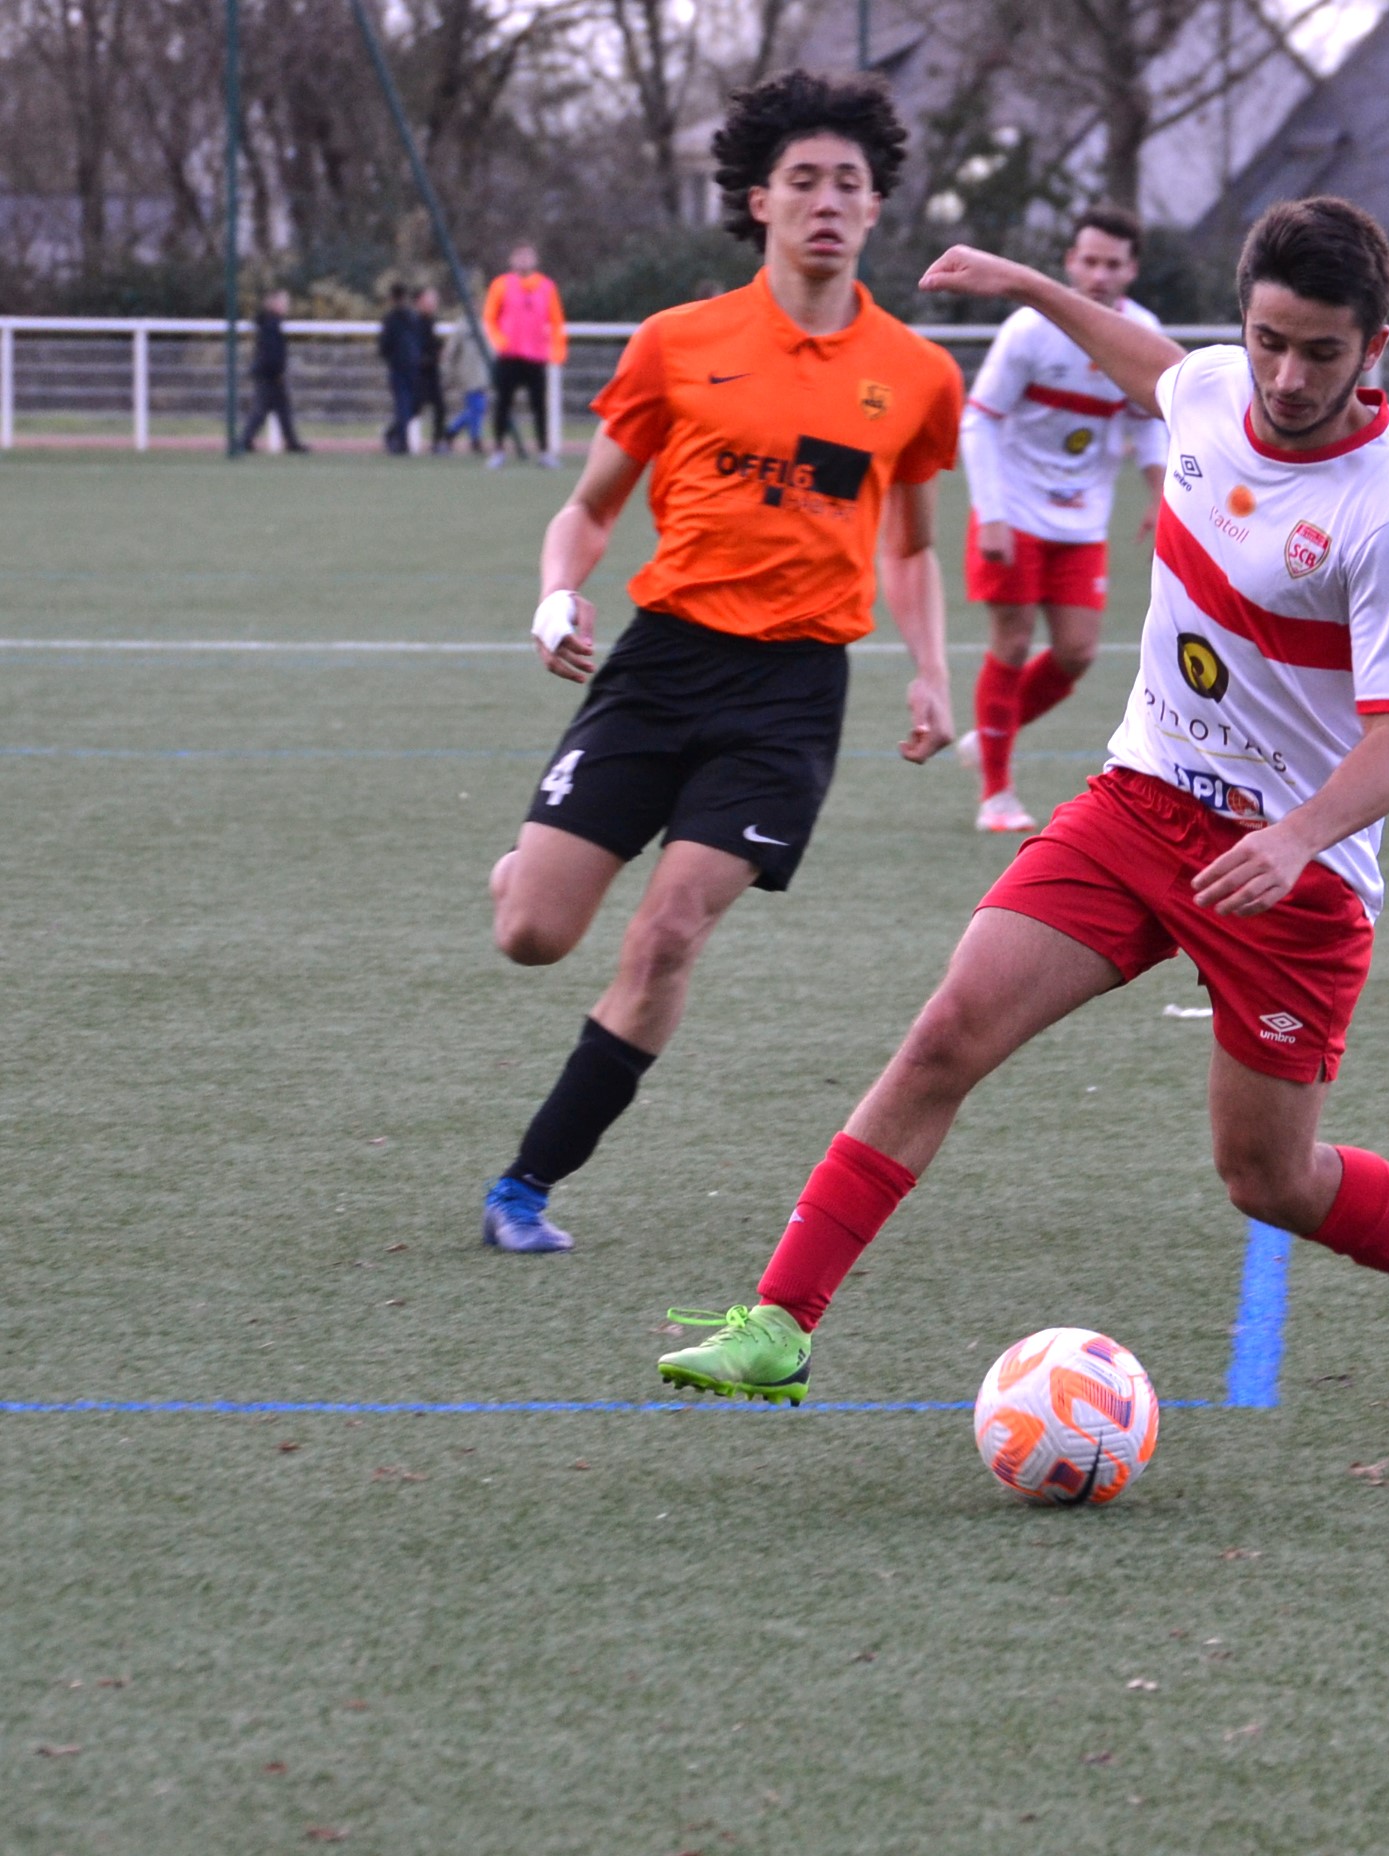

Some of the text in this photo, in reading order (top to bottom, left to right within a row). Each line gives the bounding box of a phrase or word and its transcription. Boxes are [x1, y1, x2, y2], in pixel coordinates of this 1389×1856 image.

[1173, 470, 1193, 492] umbro
[1209, 505, 1250, 544] l'atoll
[1289, 543, 1317, 569] SCB
[540, 749, 586, 806] 4
[1260, 1029, 1297, 1044] umbro
